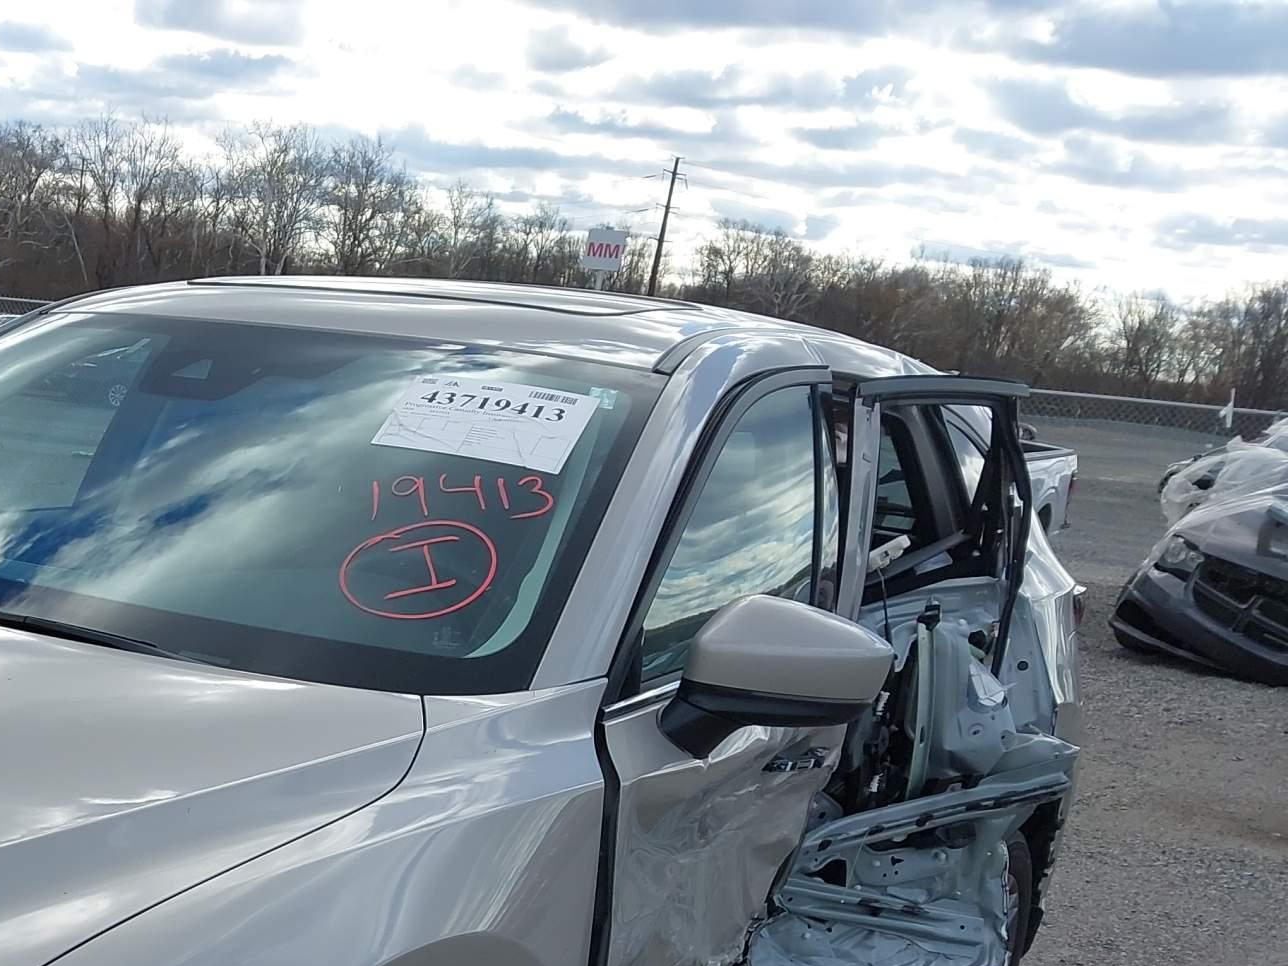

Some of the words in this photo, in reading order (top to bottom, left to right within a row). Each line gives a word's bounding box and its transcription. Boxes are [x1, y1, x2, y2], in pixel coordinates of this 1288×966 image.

[587, 242, 621, 259] MM
[420, 390, 566, 422] 43719413
[371, 473, 554, 520] 19413
